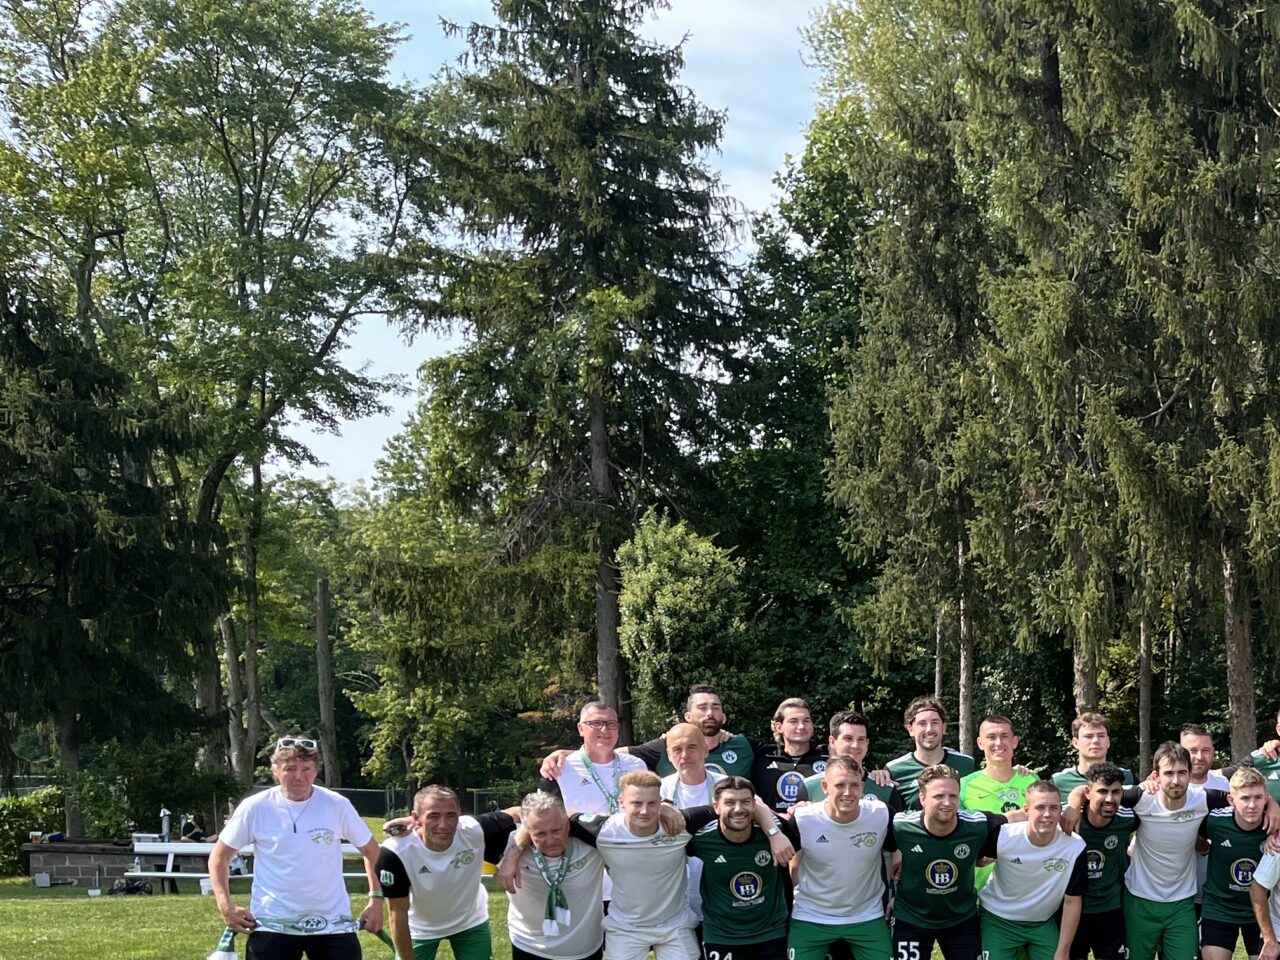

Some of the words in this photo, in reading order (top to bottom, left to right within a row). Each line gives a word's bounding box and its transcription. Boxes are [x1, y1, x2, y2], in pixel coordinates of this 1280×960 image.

[784, 785, 799, 796] HB
[934, 873, 950, 884] HB
[740, 884, 756, 896] HB
